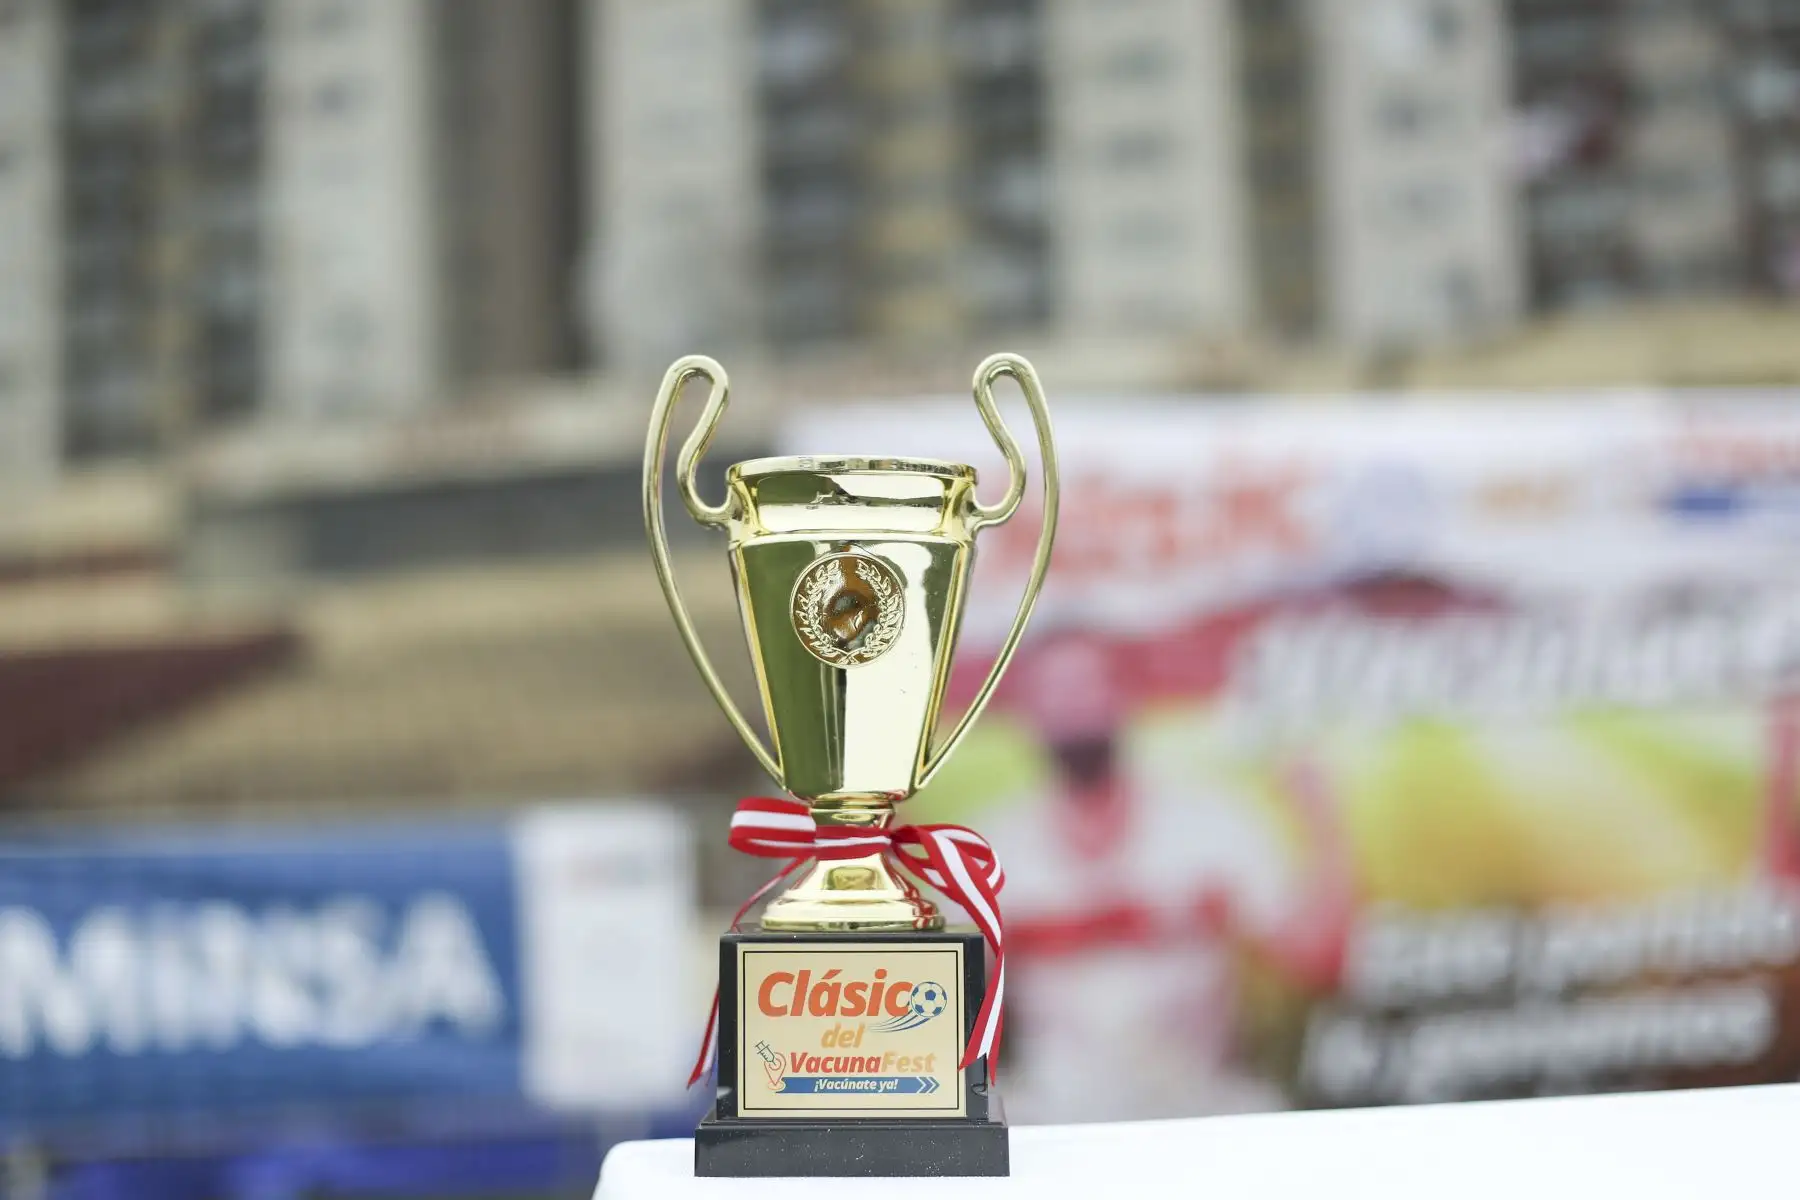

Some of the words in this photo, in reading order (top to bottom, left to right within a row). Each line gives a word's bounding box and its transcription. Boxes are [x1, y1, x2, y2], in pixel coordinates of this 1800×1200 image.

[820, 1022, 866, 1049] del
[789, 1051, 937, 1073] VacunaFest
[814, 1078, 877, 1092] ¡Vacúnate
[879, 1079, 899, 1093] ya!
